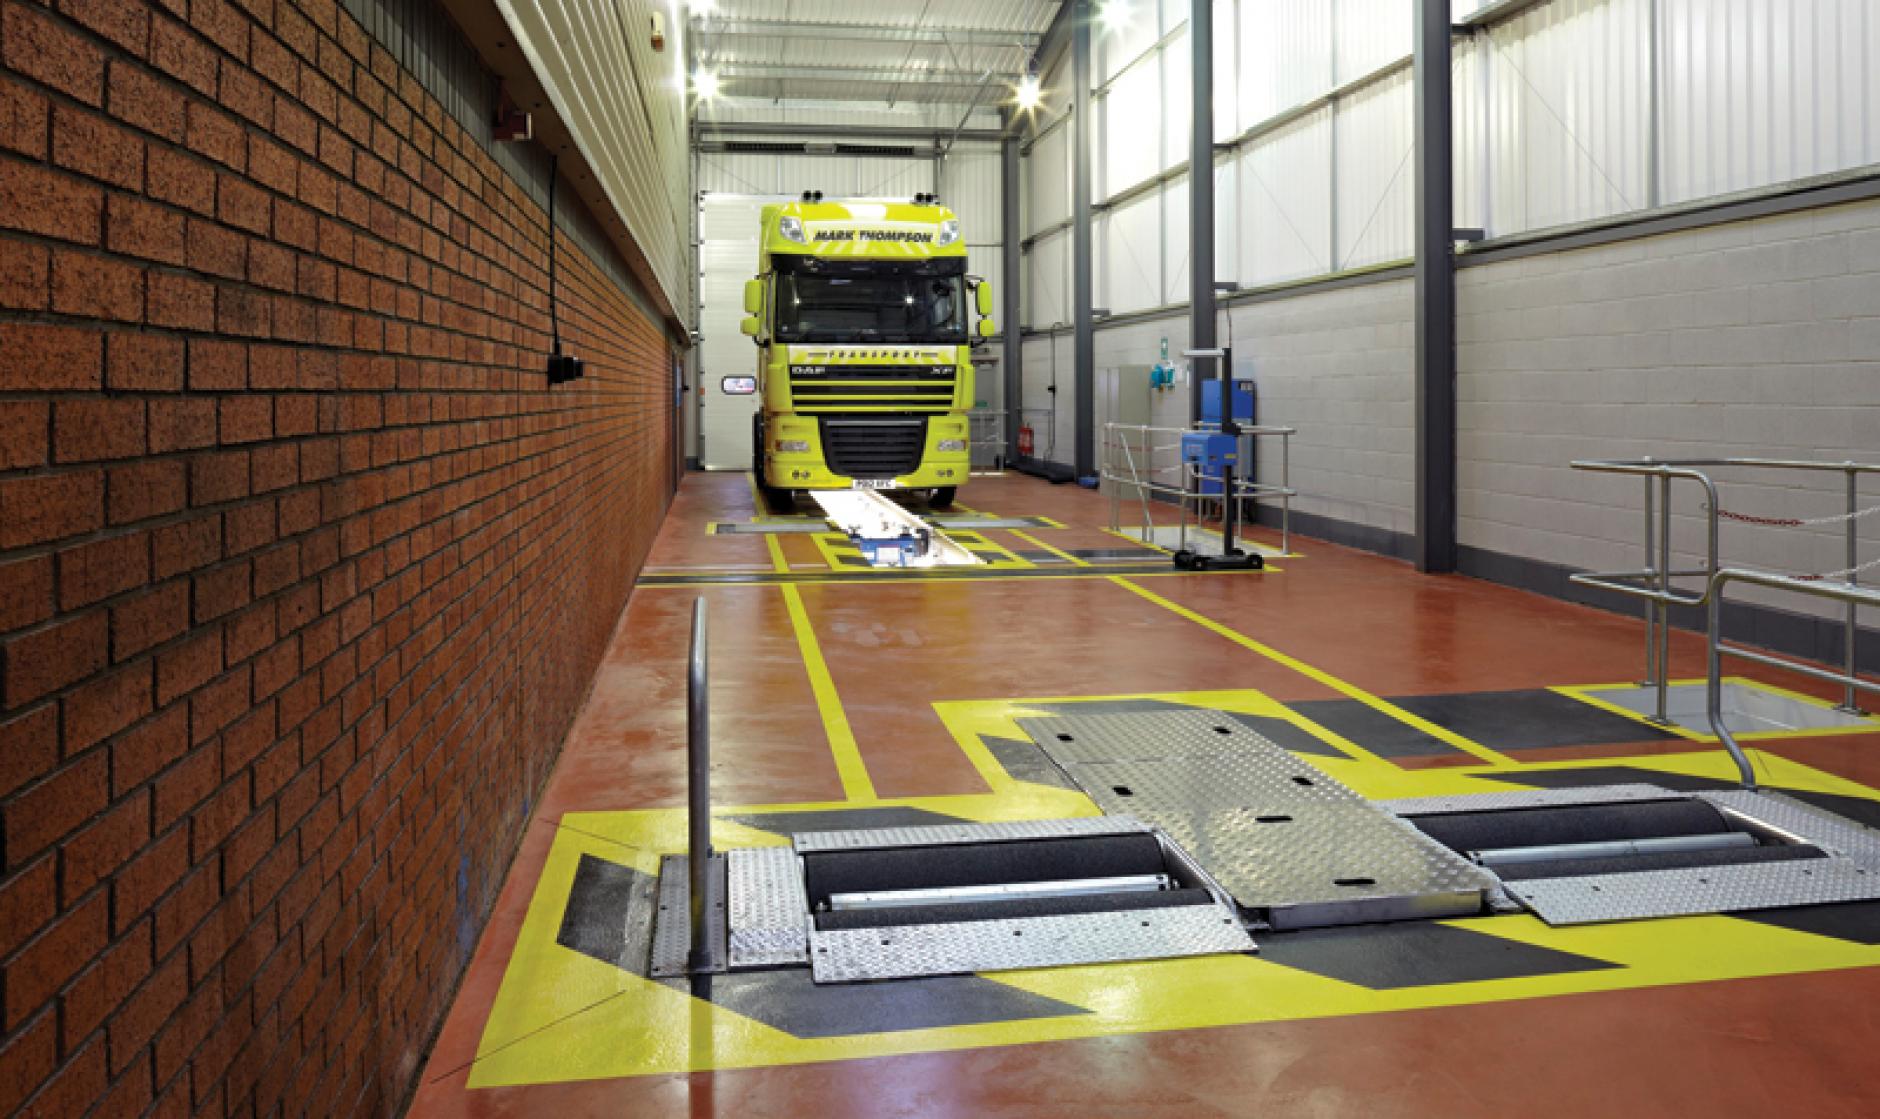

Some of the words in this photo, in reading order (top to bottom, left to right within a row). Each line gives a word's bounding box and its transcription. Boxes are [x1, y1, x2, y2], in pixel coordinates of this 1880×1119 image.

[813, 230, 854, 241] MARK
[859, 230, 933, 243] THOMPSON
[792, 366, 825, 374] DAF
